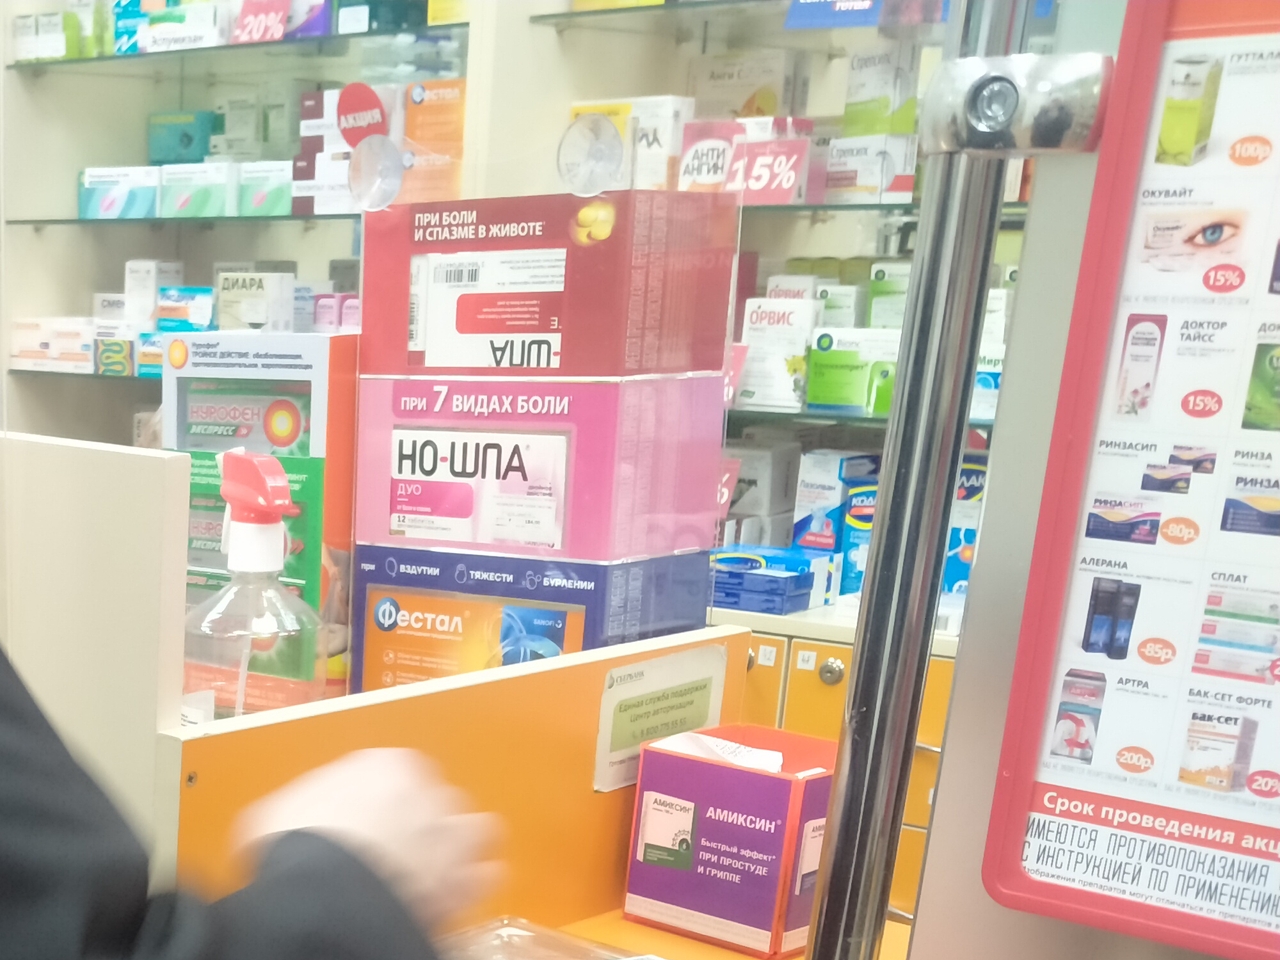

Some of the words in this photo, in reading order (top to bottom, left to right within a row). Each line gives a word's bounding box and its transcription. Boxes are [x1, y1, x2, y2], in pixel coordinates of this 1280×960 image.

[339, 108, 382, 130] АКЦИЯ
[415, 212, 440, 227] ПРИ
[442, 210, 477, 225] БОЛИ
[414, 228, 424, 242] И
[425, 225, 476, 241] СПАЗМЕ
[478, 224, 487, 239] В
[489, 221, 544, 238] ЖИВОТЕ
[221, 276, 265, 292] ДИАРА
[1207, 269, 1241, 287] 15%
[1180, 320, 1228, 331] ДОКТОР
[1180, 332, 1216, 343] ТАЙСС
[400, 396, 427, 411] ПРИ
[433, 385, 449, 413] 7
[452, 394, 513, 416] ВИДАХ
[516, 395, 570, 415] БОЛИ
[1187, 395, 1220, 412] 15%
[189, 404, 262, 422] НУРОФЕН
[188, 424, 237, 436] ЭКСПРЕСС
[1098, 439, 1158, 453] РИНЗАСИП
[397, 438, 529, 482] НО-ШПА
[1233, 450, 1273, 462] РИНЗА
[396, 483, 422, 497] ДУО
[1235, 476, 1280, 490] РИНЗА
[399, 564, 441, 577] ВЗДУТИИ
[1079, 556, 1129, 571] АЛЕРАНА
[469, 569, 514, 583] ТЯЖЕСТИ
[543, 576, 596, 591] БУРЛЕНИИ
[1210, 571, 1249, 585] СПЛАТ
[377, 601, 464, 634] Фестал
[1116, 676, 1150, 690] АРТРА
[1188, 687, 1234, 703] БАК-СЕТ
[1235, 694, 1274, 710] ФОРТЕ
[652, 797, 692, 814] АМИКСИН
[705, 806, 776, 833] АМИКСИН
[1043, 791, 1095, 817] Срок
[1099, 805, 1236, 845] проведения
[700, 837, 739, 854] Быстрый
[1024, 815, 1100, 851] ИМЕЮТСЯ
[1106, 832, 1271, 889] ПРОТИВОПОКАЗАНИЯ
[699, 851, 719, 864] ПРИ
[719, 855, 769, 877] ПРОСТУДЕ
[1021, 840, 1032, 863] С
[1034, 843, 1144, 888] ИНСТРУКЦИЕЙ
[1146, 867, 1170, 894] ПО
[696, 864, 705, 874] И
[705, 866, 742, 884] ГРИППЕ
[1077, 878, 1127, 896] препаратов
